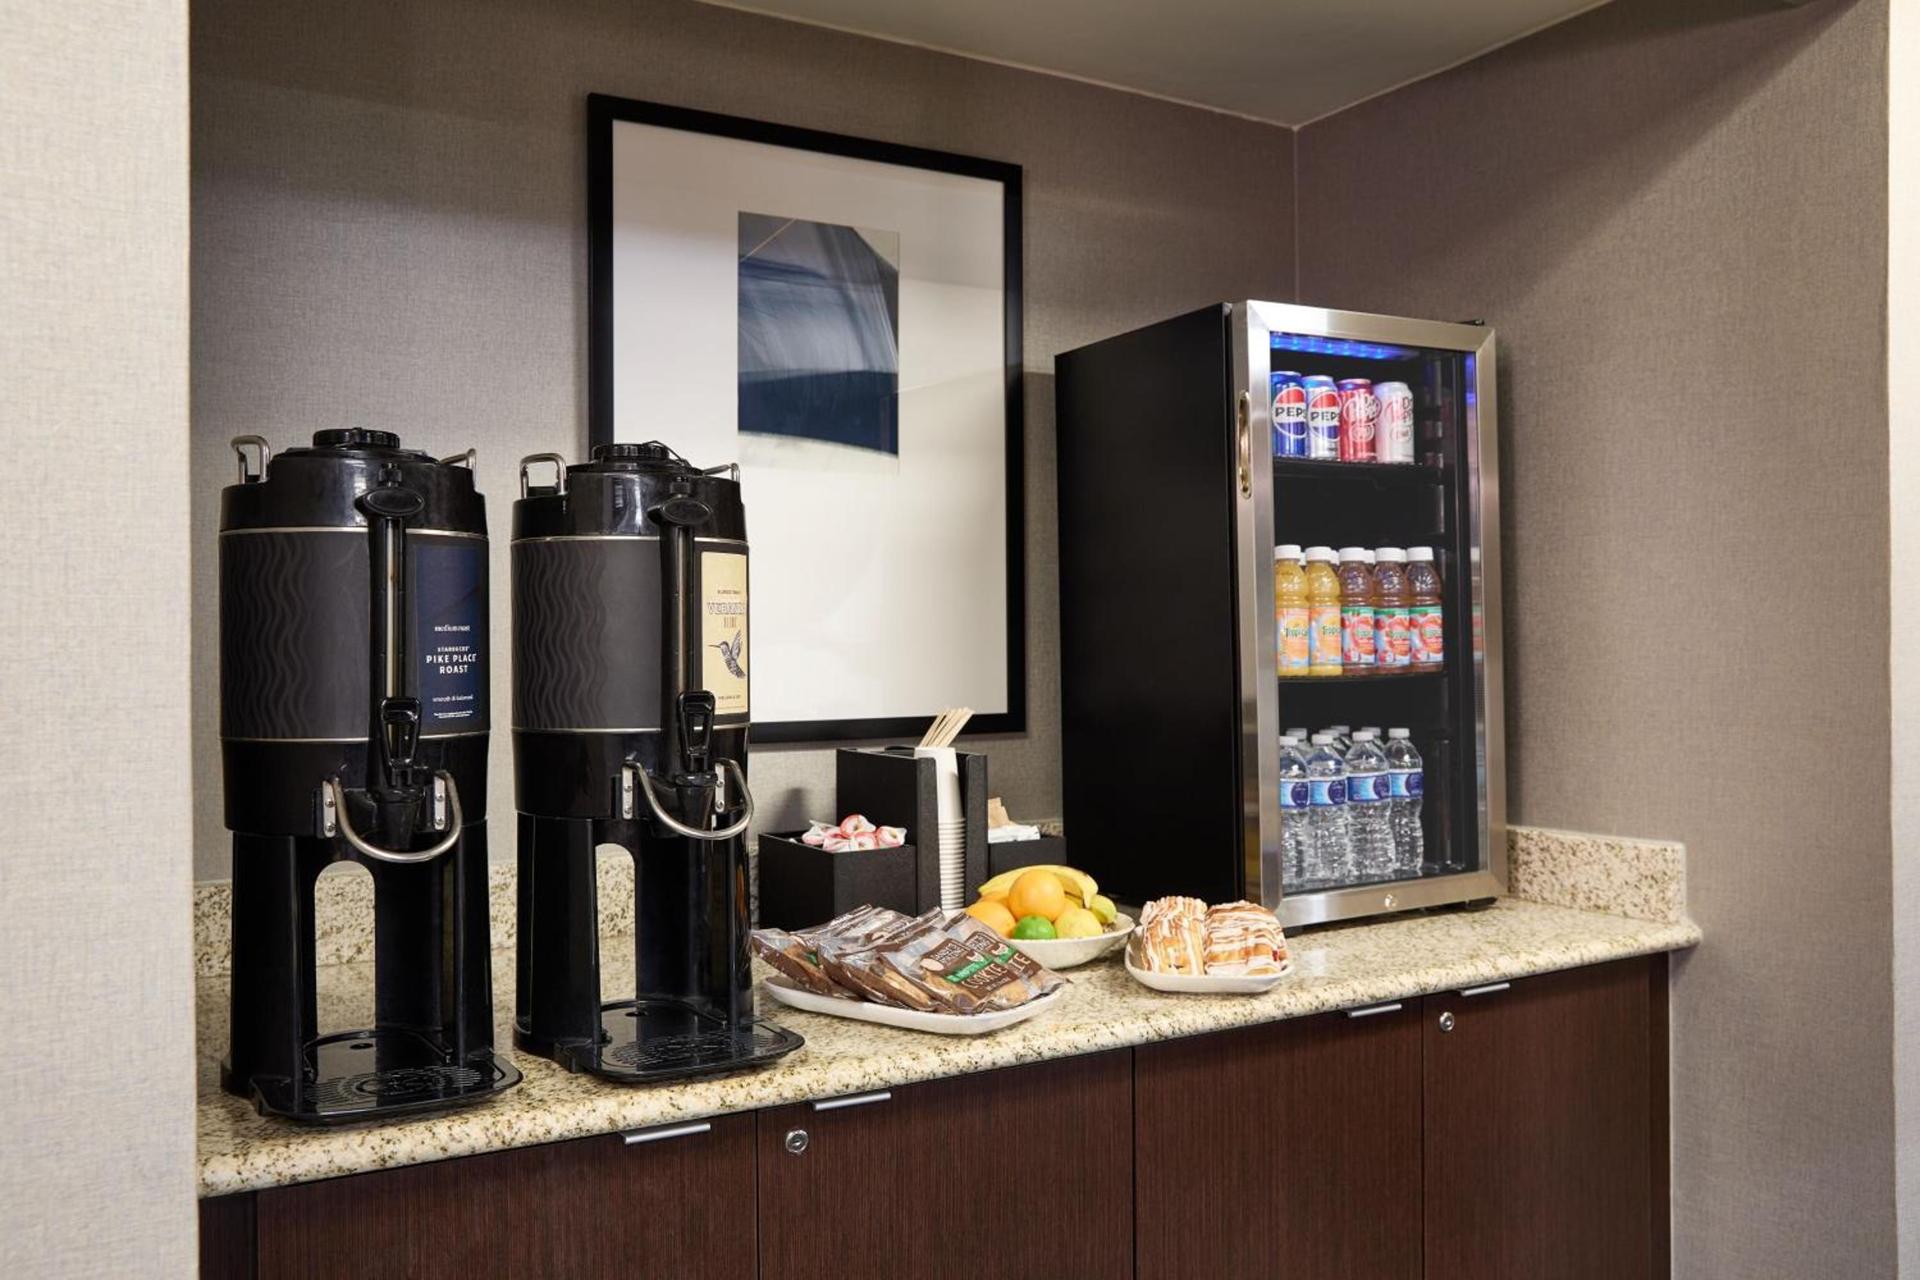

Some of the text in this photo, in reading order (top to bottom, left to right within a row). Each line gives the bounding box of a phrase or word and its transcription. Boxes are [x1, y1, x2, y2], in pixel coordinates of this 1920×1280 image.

[426, 653, 477, 664] PIKE PLACE
[439, 664, 468, 674] ROAST
[961, 962, 1008, 989] COOKIE
